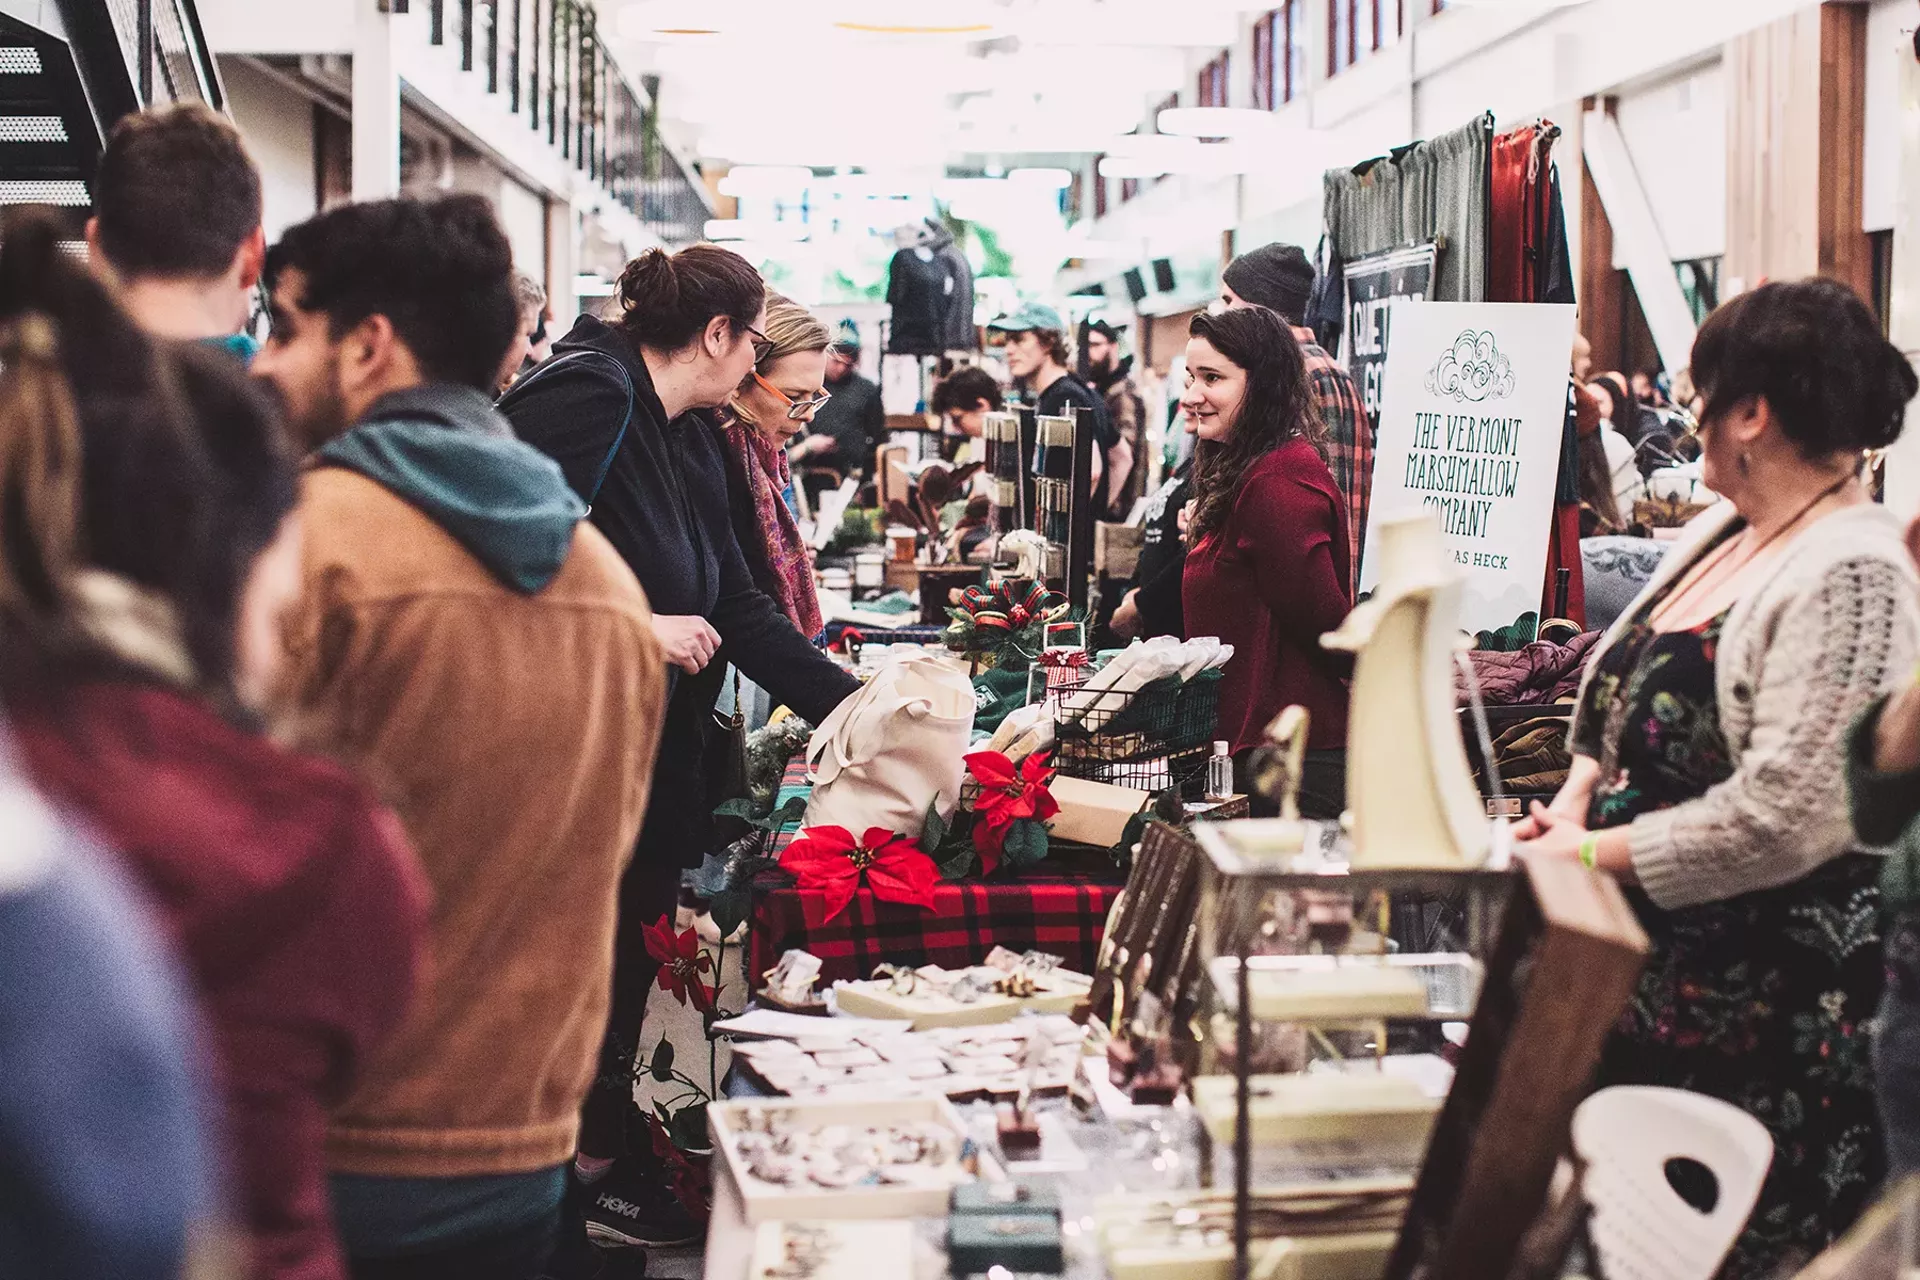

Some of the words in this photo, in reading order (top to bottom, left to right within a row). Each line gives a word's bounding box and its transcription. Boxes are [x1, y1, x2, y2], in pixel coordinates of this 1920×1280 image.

[1413, 412, 1441, 449] THE
[1447, 414, 1522, 456] VERMONT
[1404, 452, 1520, 498] MARSHMALLOW
[1454, 550, 1469, 564] AS
[1473, 552, 1508, 570] HECK
[596, 1192, 641, 1219] HOKA
